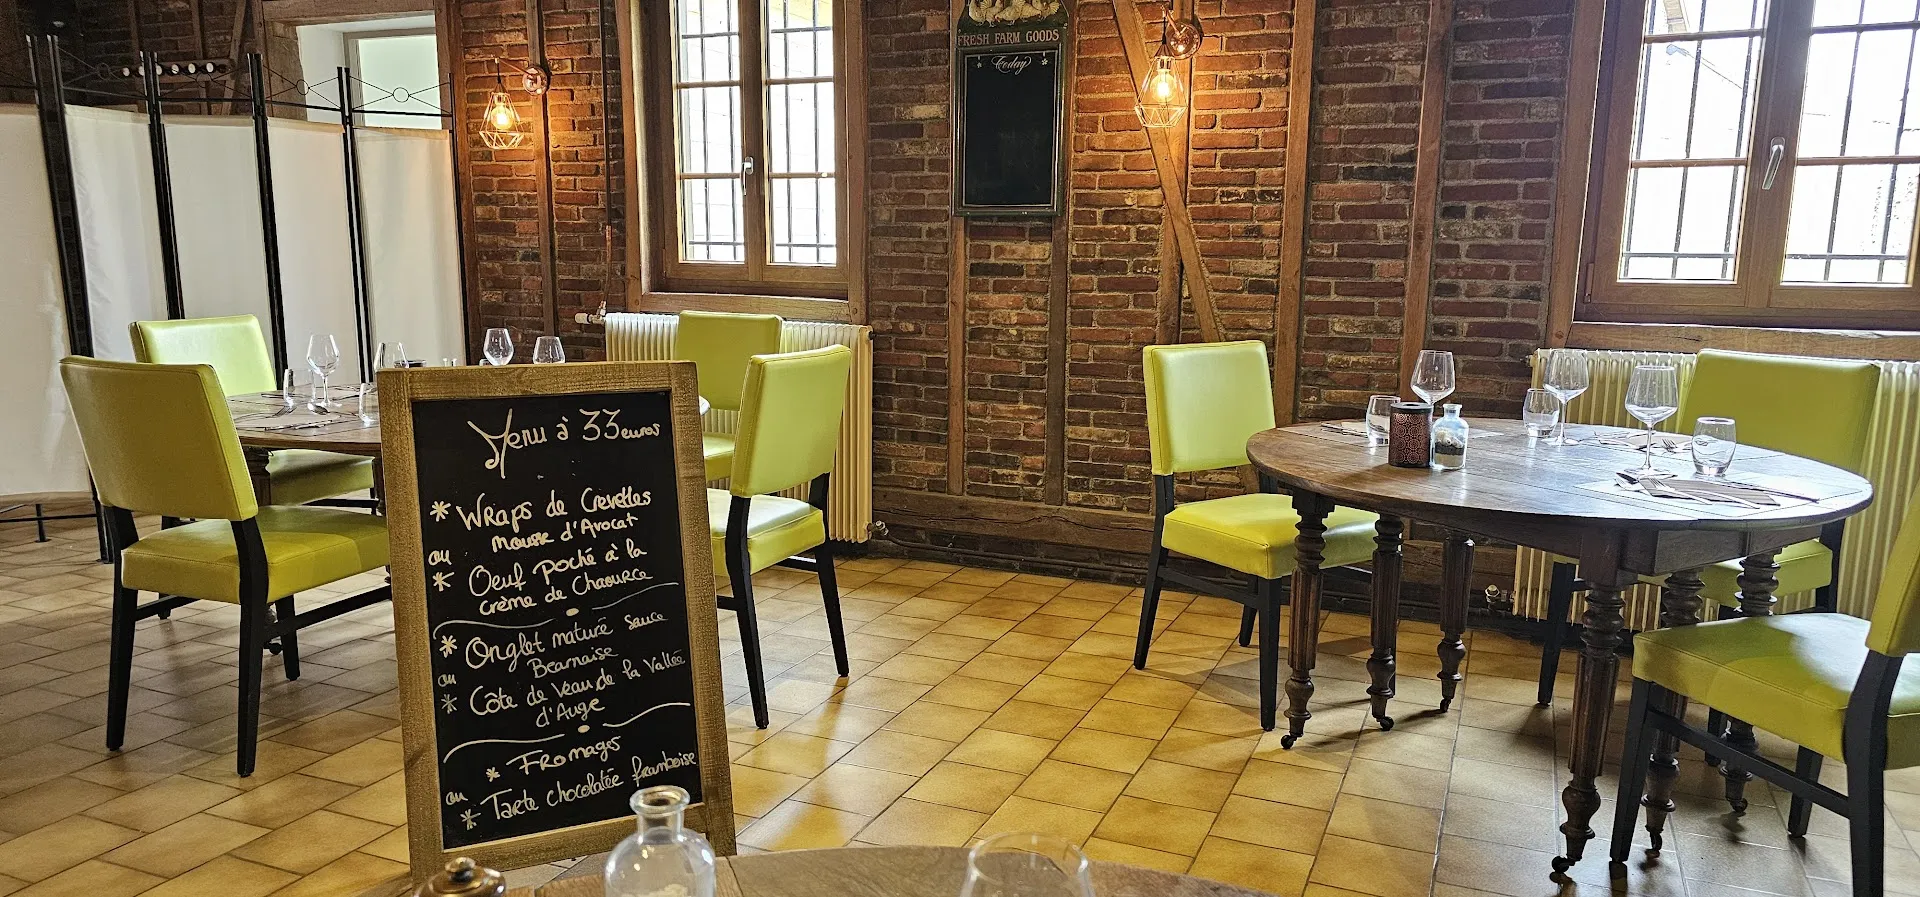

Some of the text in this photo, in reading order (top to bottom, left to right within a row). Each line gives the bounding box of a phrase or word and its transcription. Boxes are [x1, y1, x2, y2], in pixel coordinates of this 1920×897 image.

[958, 28, 1060, 47] FRESH FARM GOODS
[991, 55, 1032, 76] Today
[467, 408, 547, 479] Menu
[556, 415, 569, 441] à
[545, 489, 568, 518] de
[468, 562, 527, 597] Oeuf
[605, 542, 619, 562] à
[625, 538, 648, 559] la
[544, 586, 567, 603] de
[465, 632, 546, 673] Onglet
[552, 616, 614, 648] maturé
[469, 684, 519, 716] Côte
[526, 684, 546, 708] de
[595, 668, 615, 692] de
[622, 658, 641, 681] la
[643, 649, 686, 675] Vallée
[535, 697, 606, 728] d'Auge
